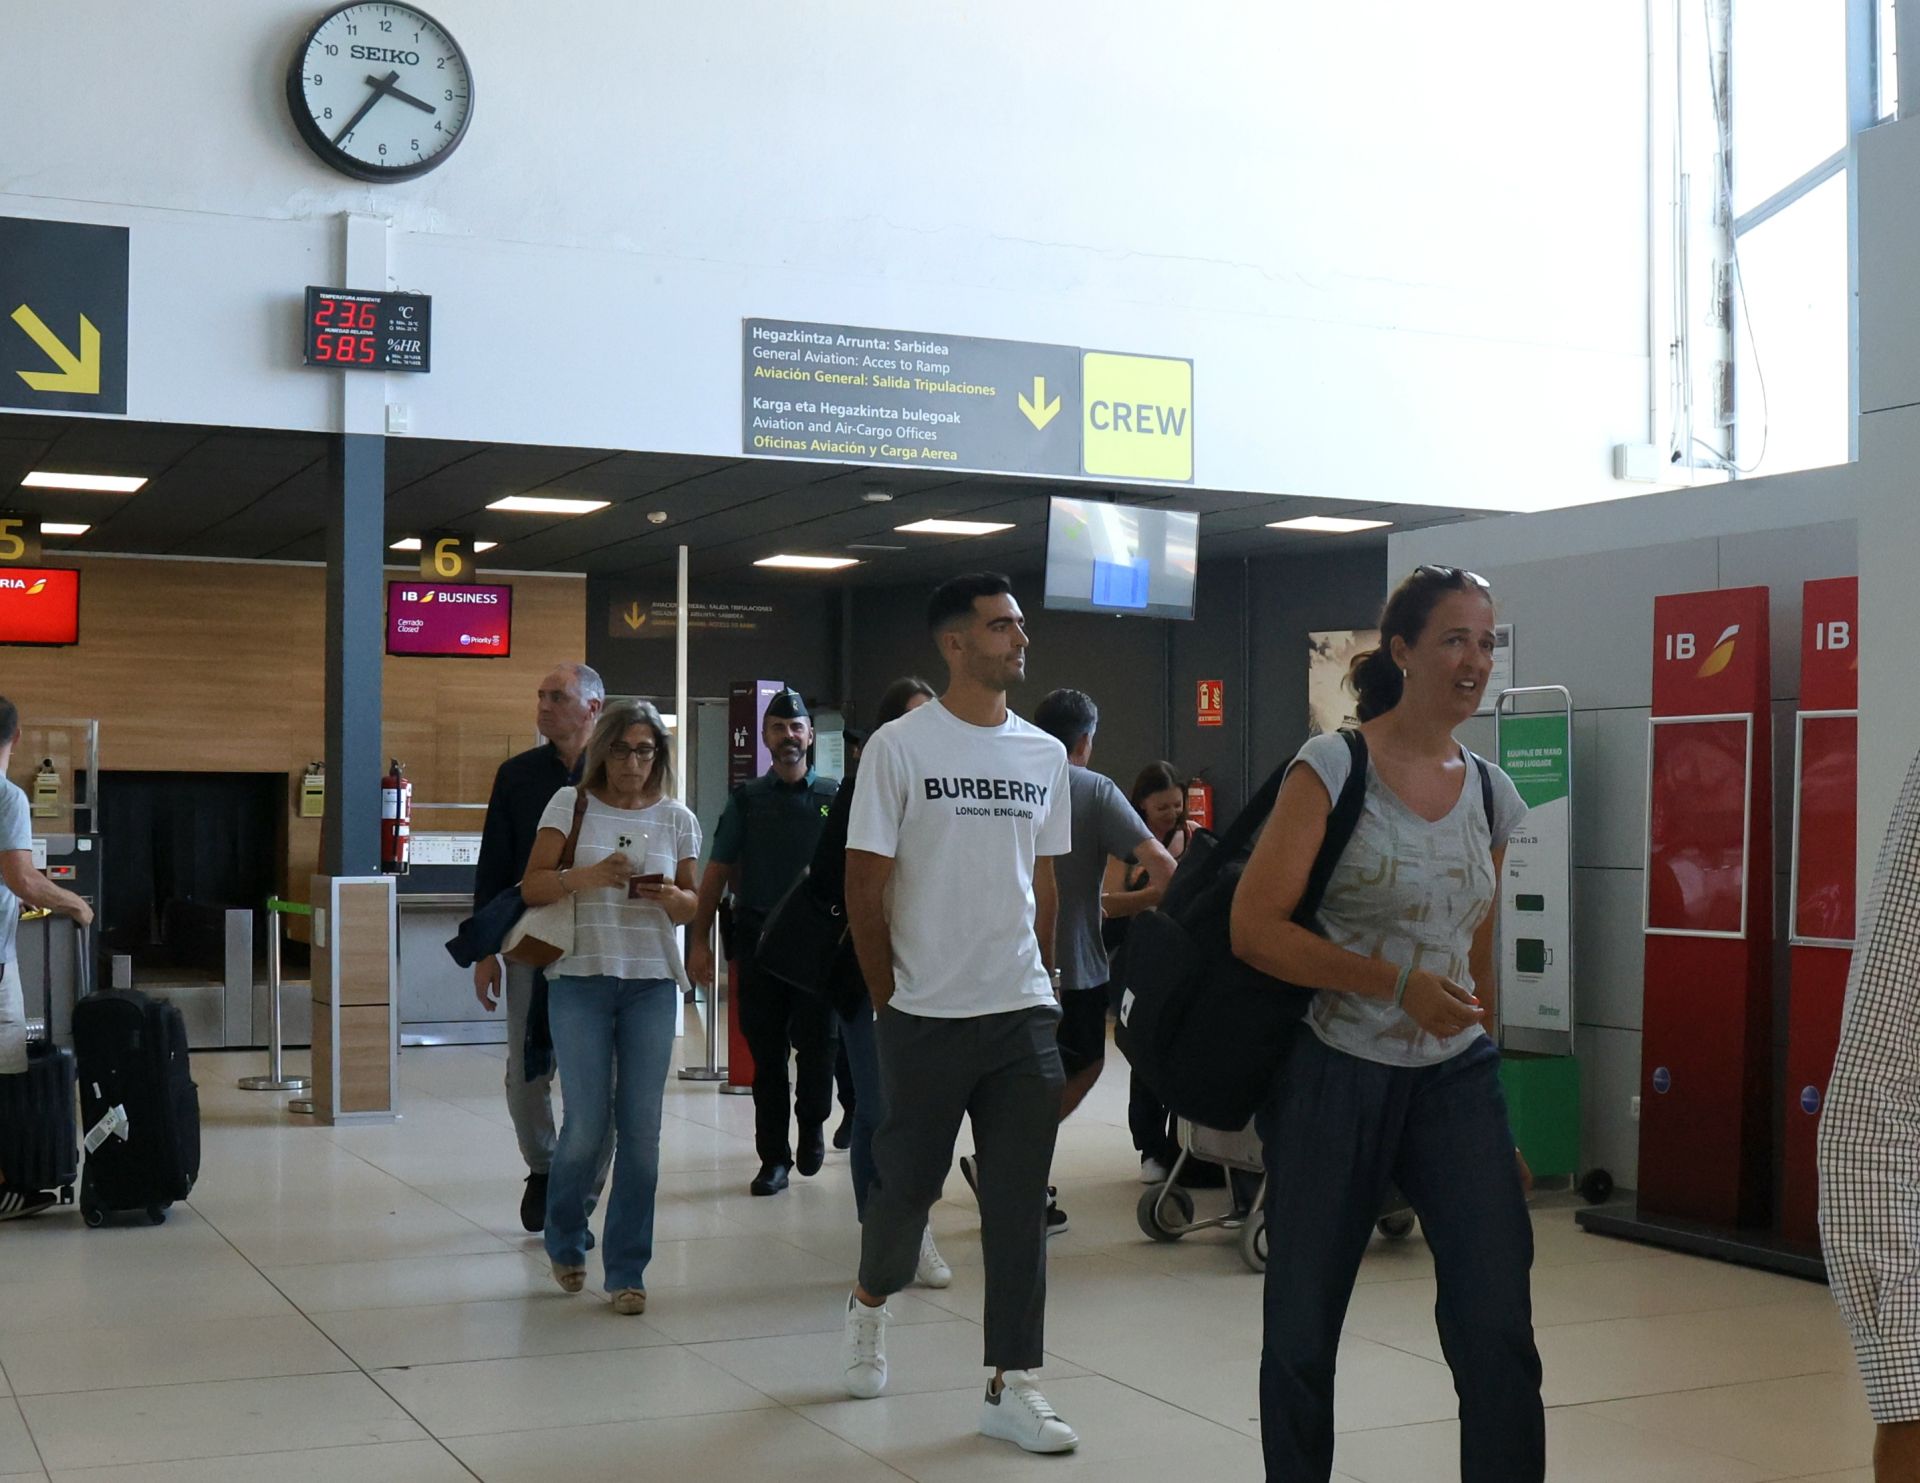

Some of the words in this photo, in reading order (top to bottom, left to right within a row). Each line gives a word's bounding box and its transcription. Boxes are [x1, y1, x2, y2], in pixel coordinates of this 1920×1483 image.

[346, 24, 358, 36] 11
[379, 21, 392, 32] 12
[413, 32, 419, 43] 1
[324, 44, 339, 56] 10
[350, 45, 420, 66] SEIKO
[436, 58, 445, 69] 2
[313, 74, 323, 86] 9
[444, 90, 453, 101] 3
[324, 107, 333, 119] 8
[433, 120, 442, 131] 4
[345, 132, 354, 143] 7
[378, 144, 387, 155] 6
[410, 139, 419, 150] 5
[387, 338, 421, 353] %HR
[752, 327, 833, 346] Hegazkintza
[835, 335, 891, 352] Arrunta:
[893, 340, 949, 356] Sarbidea
[752, 348, 801, 362] General
[804, 352, 859, 367] Aviation:
[862, 356, 897, 370] Acces
[900, 360, 913, 371] to
[916, 360, 951, 375] Ramp
[754, 366, 811, 381] Aviación
[814, 370, 869, 386] General:
[872, 375, 911, 390] Salida
[914, 379, 996, 396] Tripulaciones
[753, 397, 792, 414] Karga
[795, 402, 816, 413] eta
[820, 402, 898, 419] Hegazkintza
[902, 409, 961, 425] bulegoak
[1090, 400, 1187, 437] CREW
[752, 416, 805, 431] Aviation
[808, 420, 832, 433] and
[834, 422, 893, 439] Air-Cargo
[896, 426, 938, 440] Offices
[754, 435, 807, 451] Oficinas
[810, 439, 866, 454] Aviación
[869, 445, 877, 457] y
[880, 444, 919, 460] Carga
[921, 447, 959, 461] Aerea
[0, 518, 25, 560] 5
[434, 538, 462, 577] 6
[402, 591, 418, 601] IB
[438, 592, 498, 604] BUSINESS
[397, 618, 424, 627] Cerrado
[470, 637, 492, 646] Priority
[1816, 621, 1850, 650] IB
[1665, 633, 1696, 661] IB
[924, 777, 1047, 806] BURBERRY
[955, 806, 991, 816] LONDON
[993, 807, 1034, 820] ENGLAND
